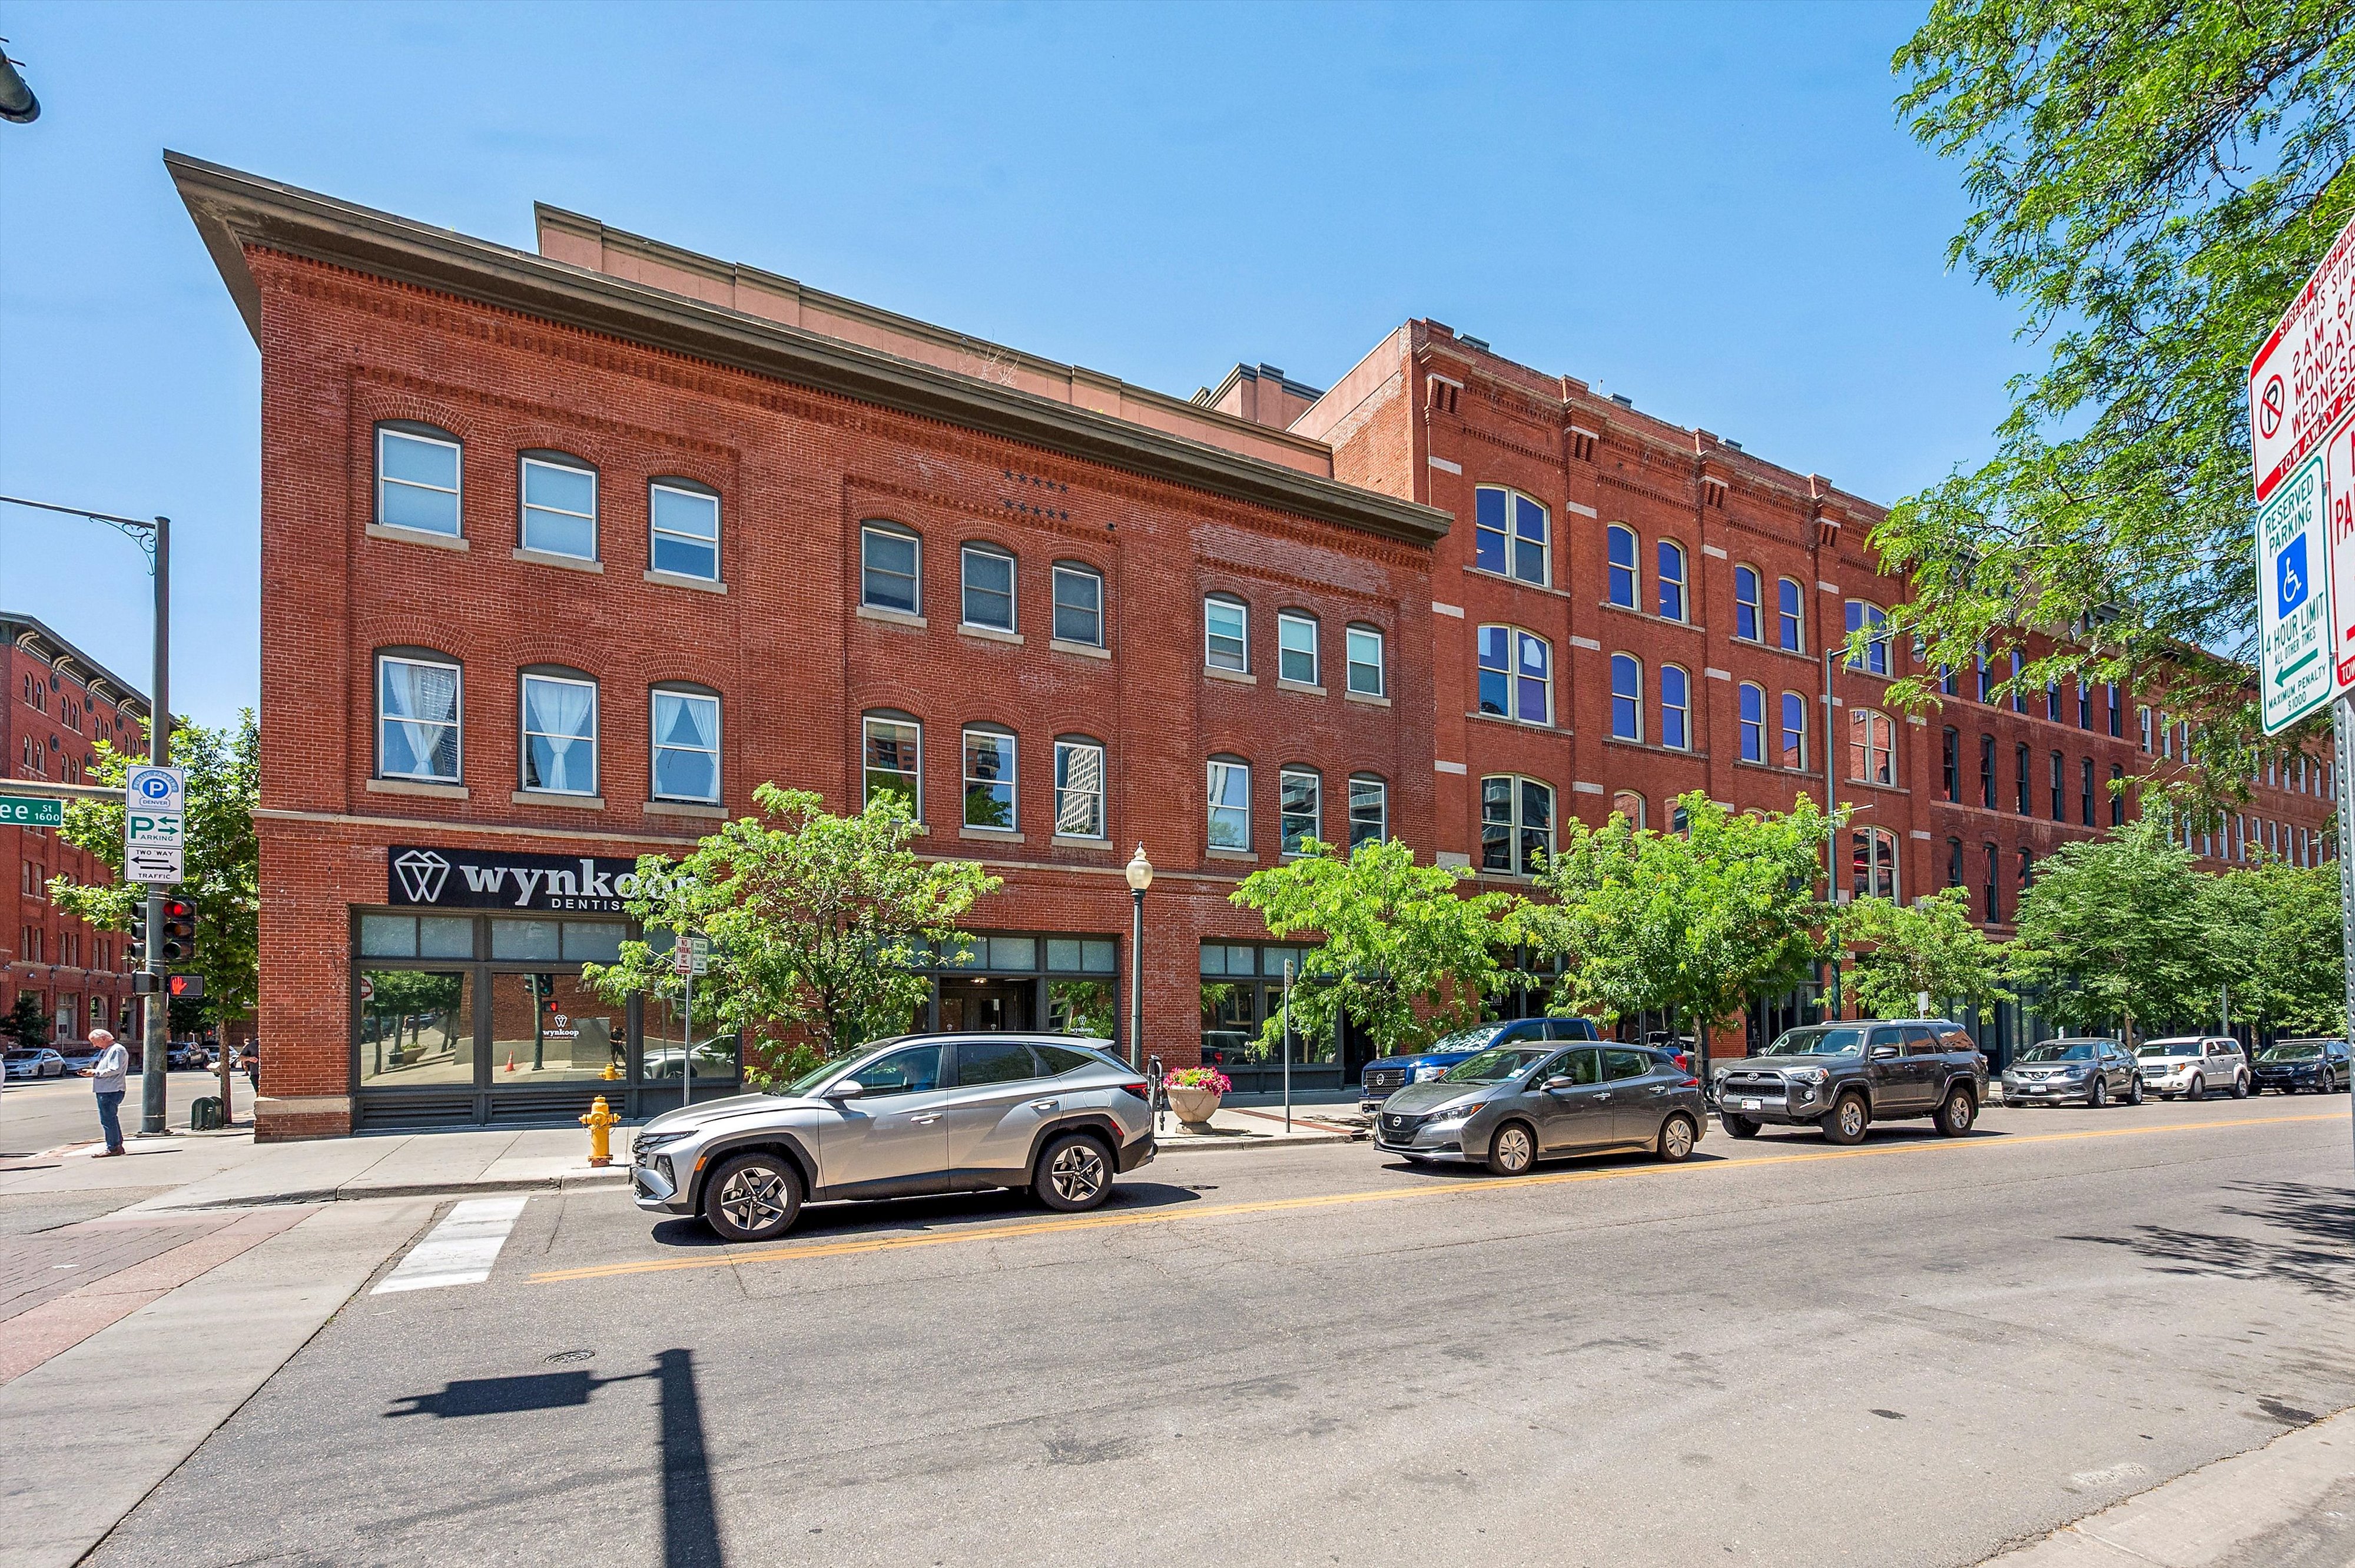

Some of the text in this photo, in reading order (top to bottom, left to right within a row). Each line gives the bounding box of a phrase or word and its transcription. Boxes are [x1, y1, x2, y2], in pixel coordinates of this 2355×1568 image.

[2279, 287, 2309, 340] STREET
[2303, 246, 2355, 332] THIS SIDE
[2295, 310, 2354, 406] MONDAY
[2278, 442, 2300, 477] TOW
[2303, 401, 2336, 451] AWAY
[2265, 473, 2314, 538] RESERVED
[2269, 500, 2312, 558] PARKING
[2336, 485, 2355, 546] PA
[2266, 591, 2324, 656] 4 HOUR LIMIT
[2274, 626, 2317, 667] ALL OTHER TIMES
[2268, 663, 2327, 710] MAXIMUM PENALTY
[2287, 691, 2307, 711] $1000
[133, 771, 178, 791] PUBLIC PARKING
[0, 804, 28, 820] ee
[35, 813, 59, 822] 1600
[542, 1028, 579, 1037] wynkoop
